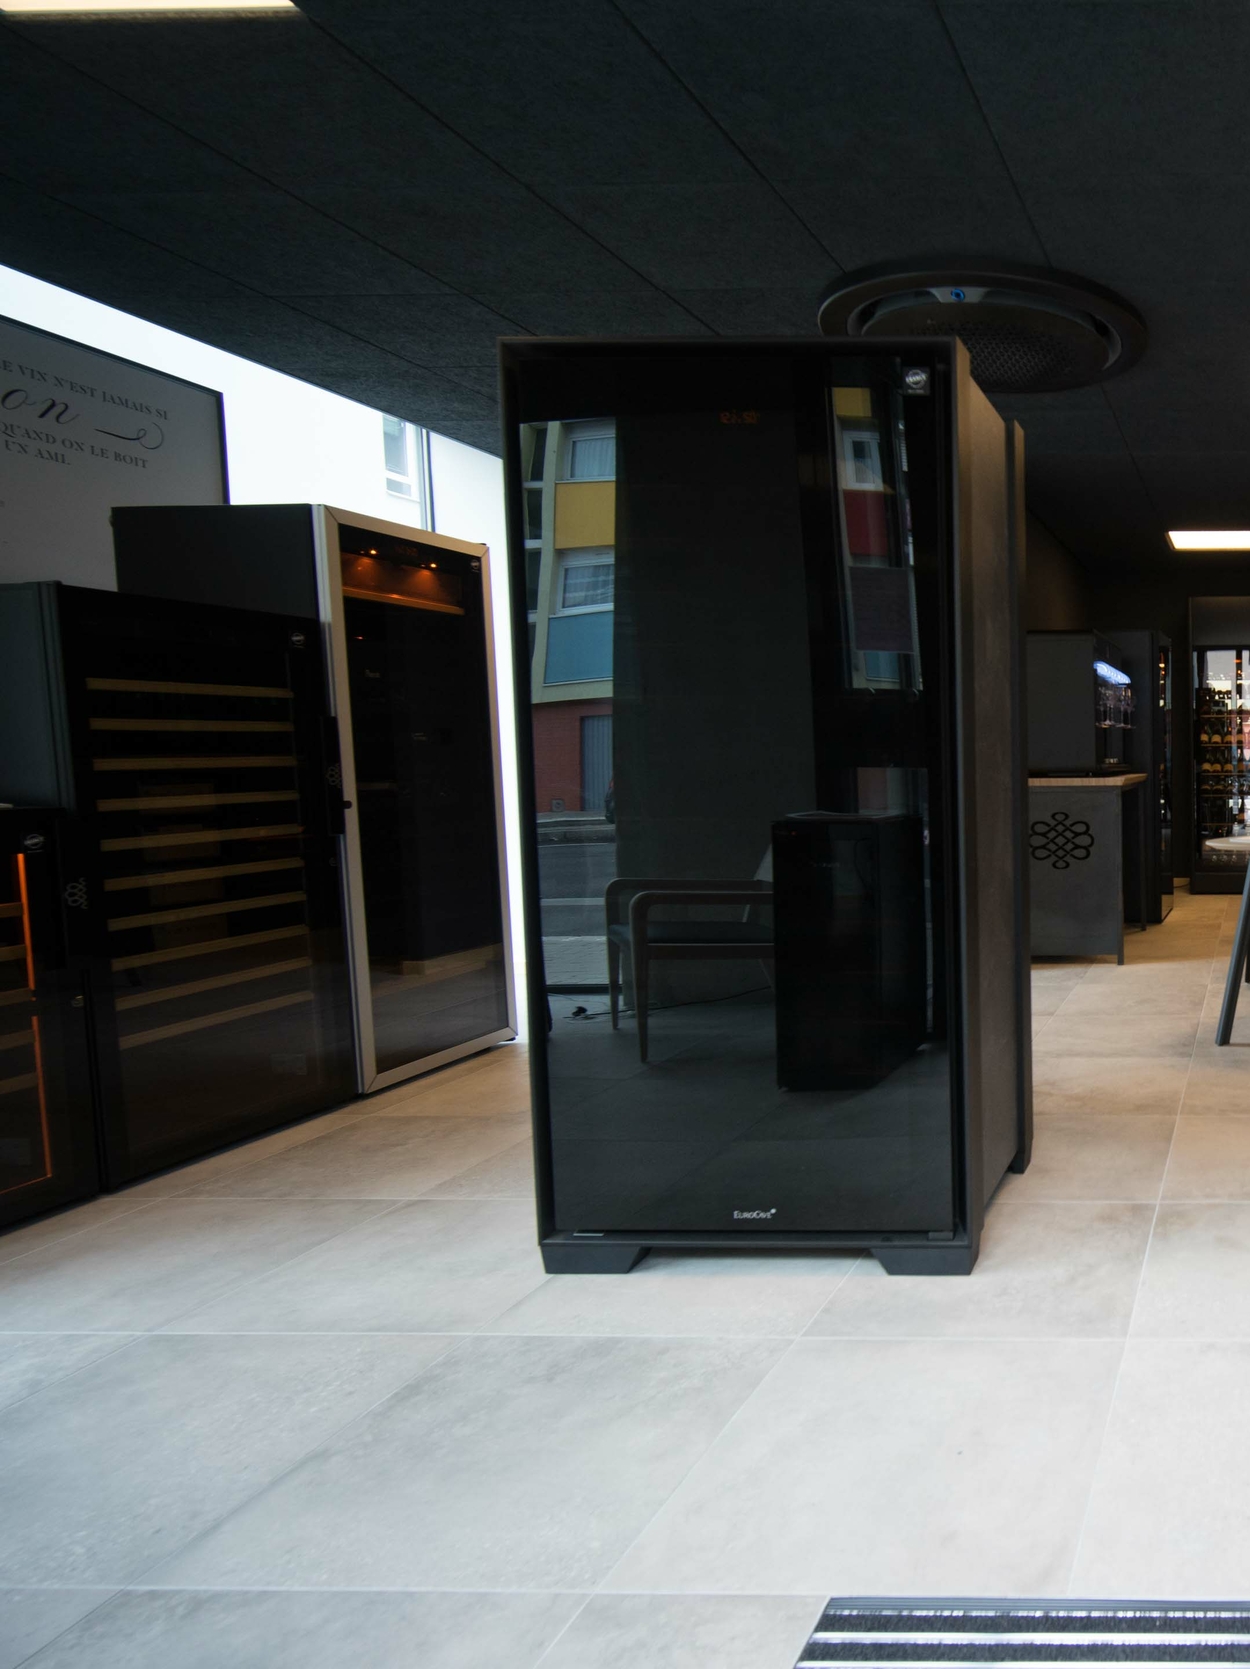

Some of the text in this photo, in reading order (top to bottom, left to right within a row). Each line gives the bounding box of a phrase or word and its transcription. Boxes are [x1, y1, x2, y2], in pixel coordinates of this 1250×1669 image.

[0, 360, 13, 372] E
[18, 364, 47, 382] VIN
[54, 375, 97, 397] N'EST
[156, 408, 167, 420] SI
[0, 421, 148, 469] QUAND ON LE BOIT
[4, 439, 71, 465] UN AMI.
